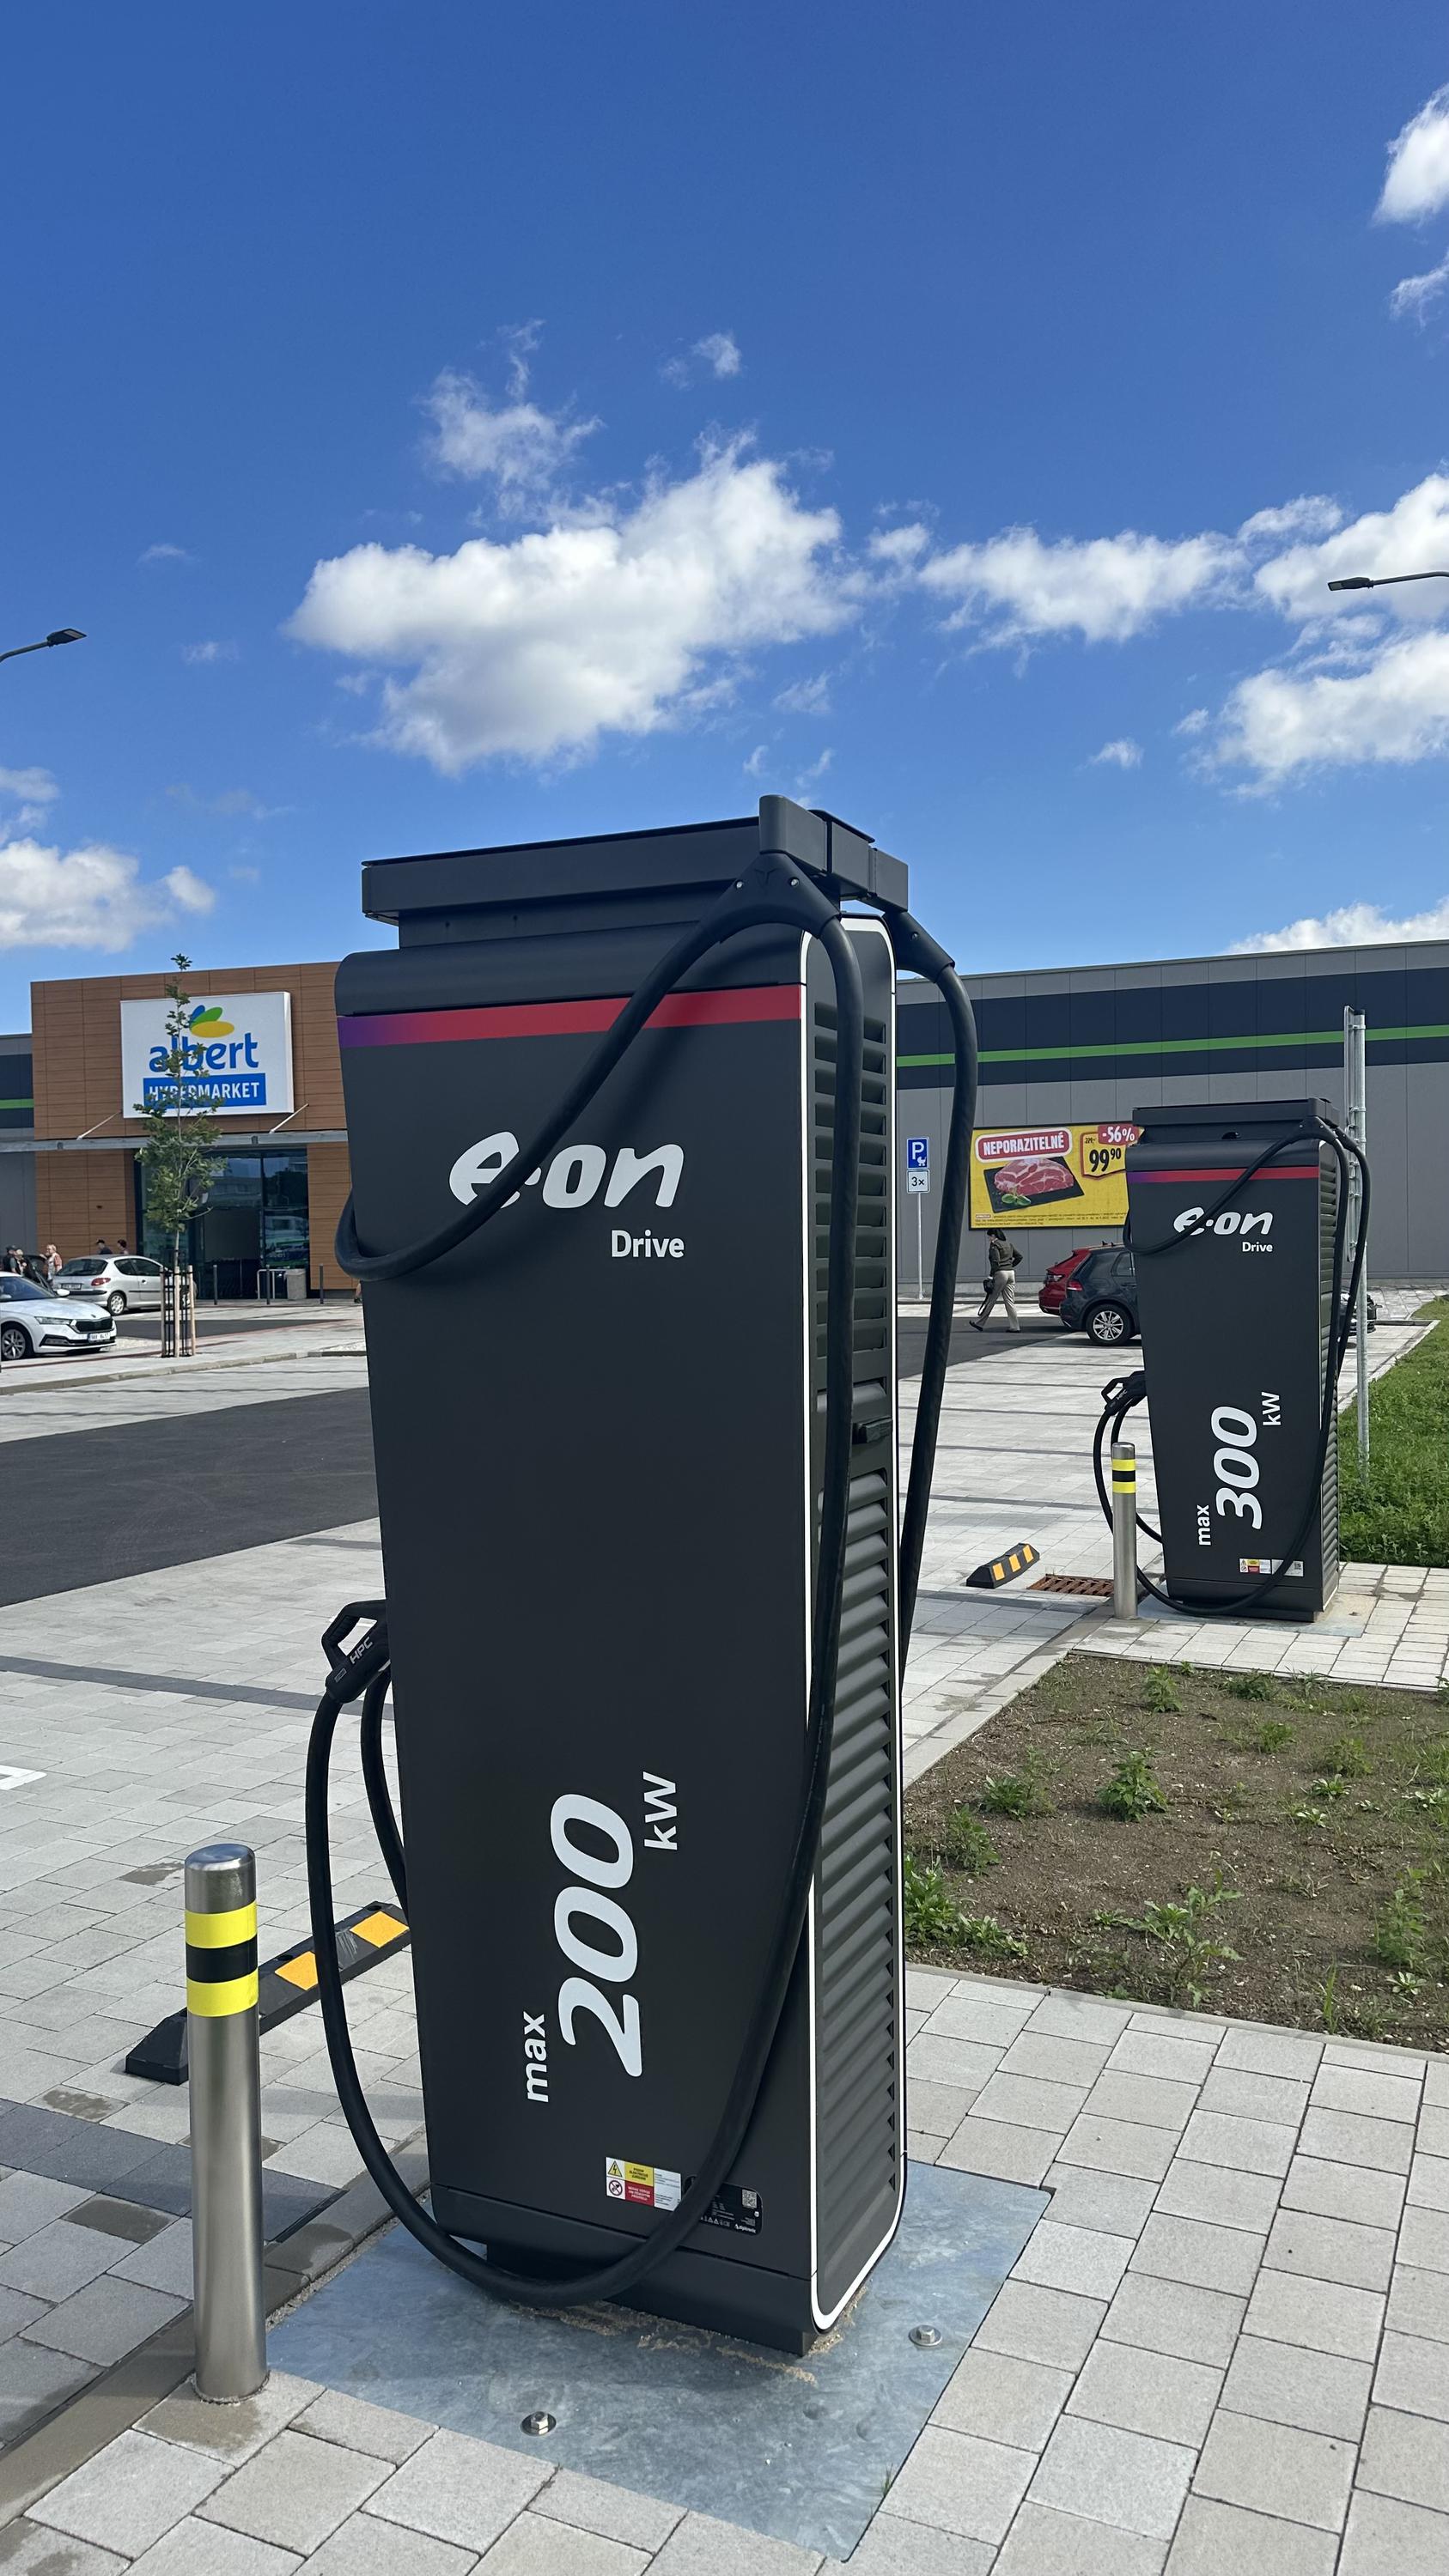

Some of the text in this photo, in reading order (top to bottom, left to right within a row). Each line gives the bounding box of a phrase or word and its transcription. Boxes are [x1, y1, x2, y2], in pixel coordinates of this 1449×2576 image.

[983, 1132, 1065, 1157] NEPORAZITELNÉ
[1102, 1126, 1135, 1143] -56%
[912, 1141, 925, 1160] P
[611, 1229, 685, 1259] Drive
[1241, 1241, 1274, 1253] Drive
[1196, 1391, 1282, 1546] max 300 kW
[349, 1636, 374, 1665] HPC
[523, 1771, 679, 2103] max 200 kW
